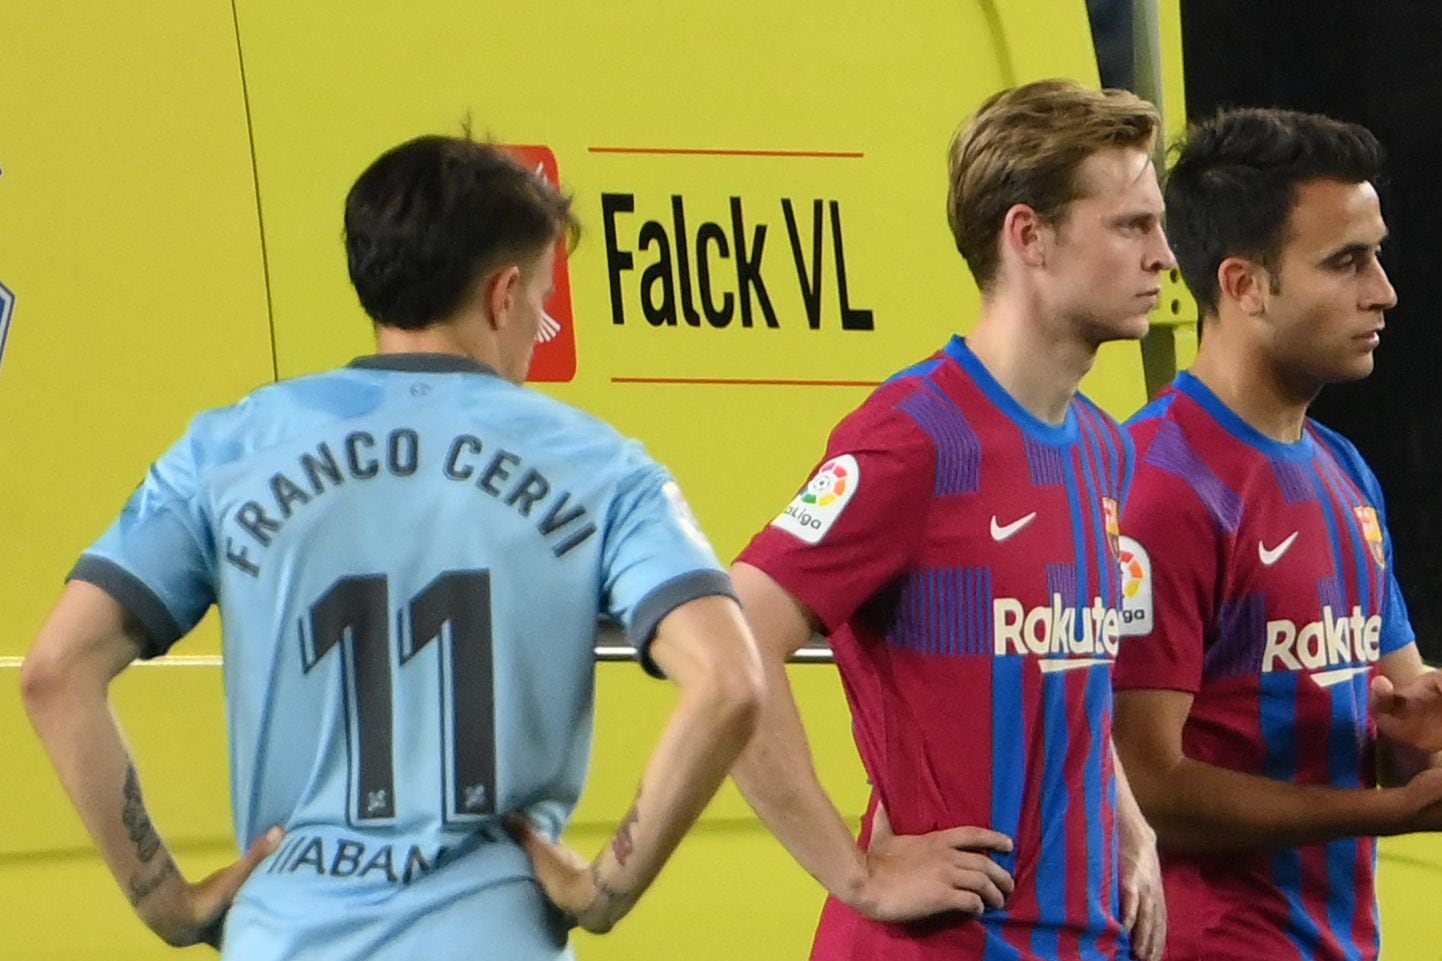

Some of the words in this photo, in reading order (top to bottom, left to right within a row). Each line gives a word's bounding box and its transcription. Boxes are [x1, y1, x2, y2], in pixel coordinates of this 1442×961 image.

[600, 193, 780, 328] Falck
[781, 198, 875, 331] VL
[225, 427, 419, 578] FRANCO
[442, 434, 597, 558] CERVI
[299, 568, 498, 827] 11
